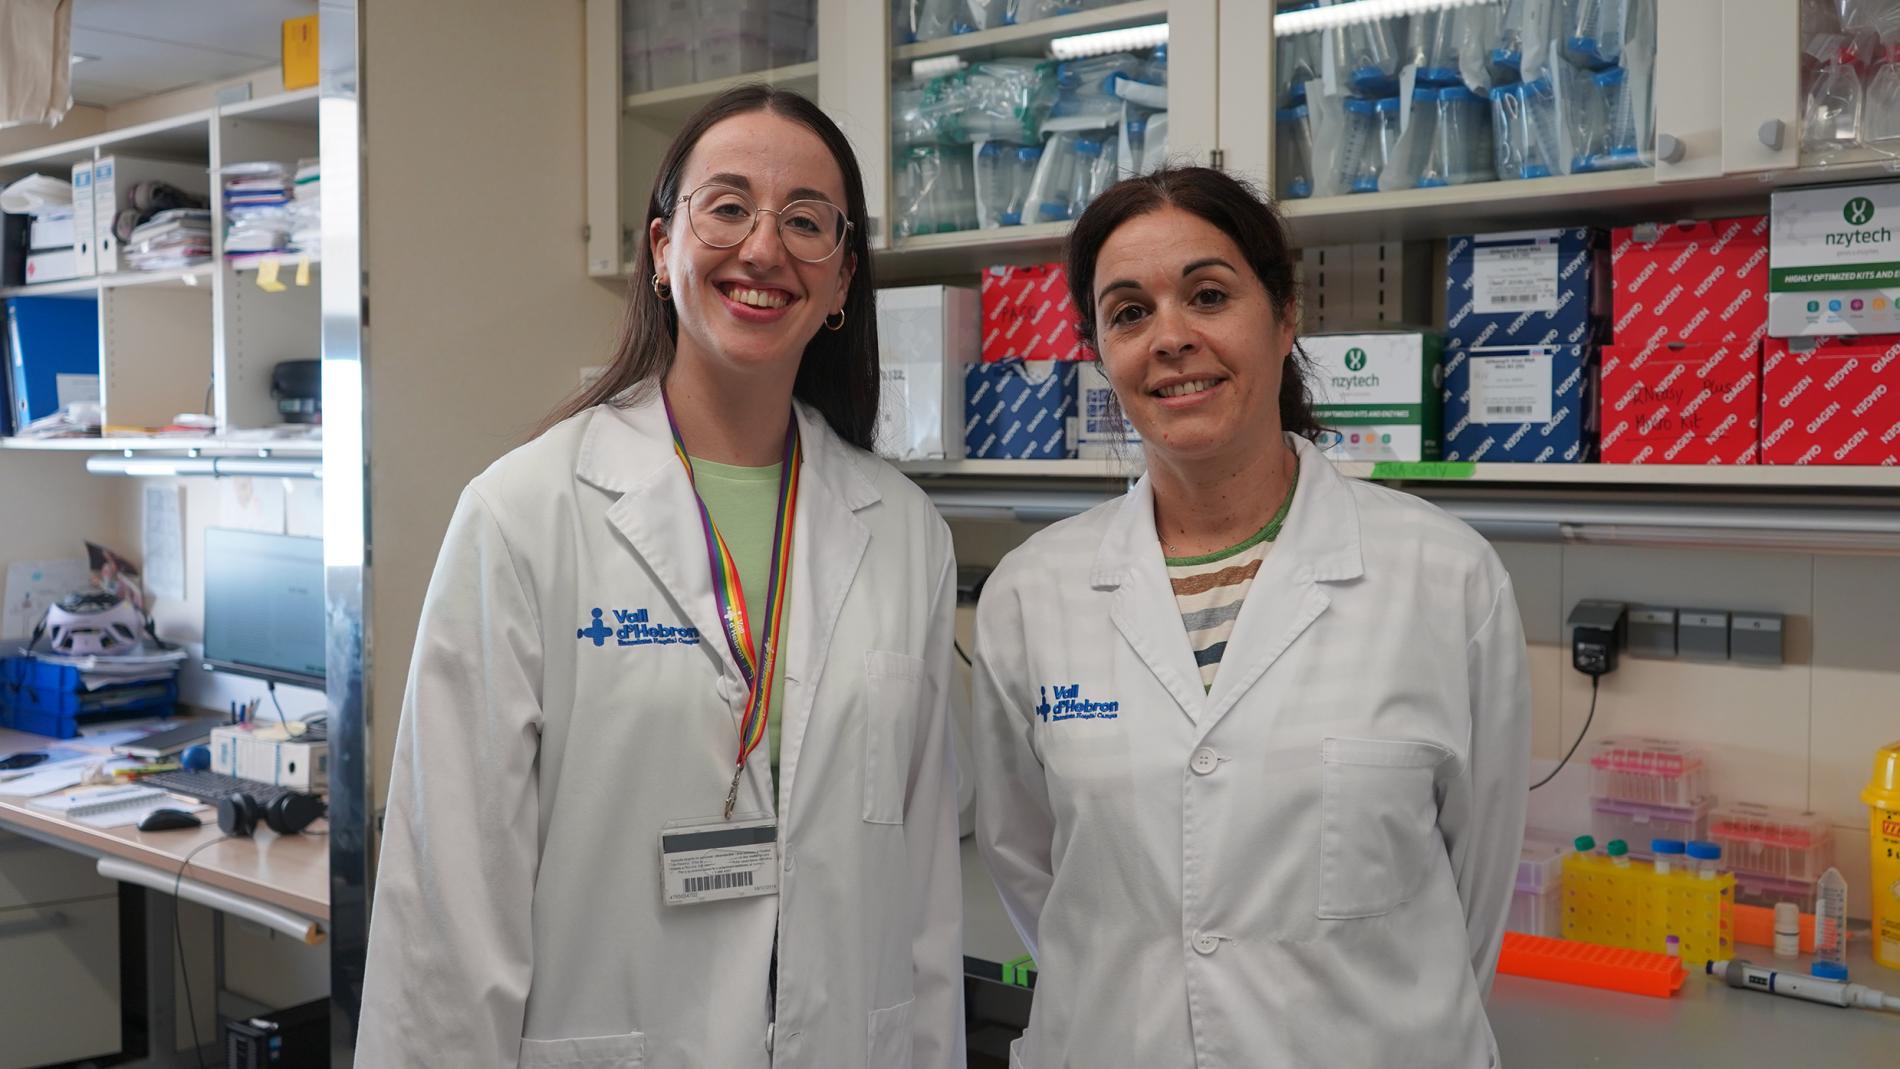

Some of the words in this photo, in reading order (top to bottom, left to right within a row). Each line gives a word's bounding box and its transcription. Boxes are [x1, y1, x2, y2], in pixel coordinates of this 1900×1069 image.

[1710, 222, 1741, 255] QIAGEN
[1826, 226, 1891, 248] nzytech
[1628, 261, 1658, 293] QIAGEN
[1694, 265, 1725, 298] QIAGEN
[1784, 274, 1812, 284] HIGHLY
[1813, 272, 1856, 282] OPTIMIZED
[1856, 270, 1875, 280] KITS
[1876, 270, 1894, 278] AND
[1654, 284, 1684, 316] QIAGEN
[1720, 289, 1752, 322] QIAGEN
[1680, 307, 1710, 339] QIAGEN
[1696, 347, 1728, 378] QIAGEN
[1824, 358, 1858, 390] QIAGEN
[1332, 374, 1380, 390] nzytech
[1723, 372, 1755, 404] QIAGEN
[1779, 375, 1812, 408] QIAGEN
[1852, 384, 1887, 417] QIAGEN
[1806, 401, 1840, 434] QIAGEN
[1664, 430, 1695, 460] QIAGEN
[1834, 428, 1868, 460] QIAGEN
[612, 608, 648, 623] Vall
[616, 623, 700, 639] d'Hebron
[1053, 684, 1079, 700] Vall
[1053, 698, 1119, 714] d'Hebron
